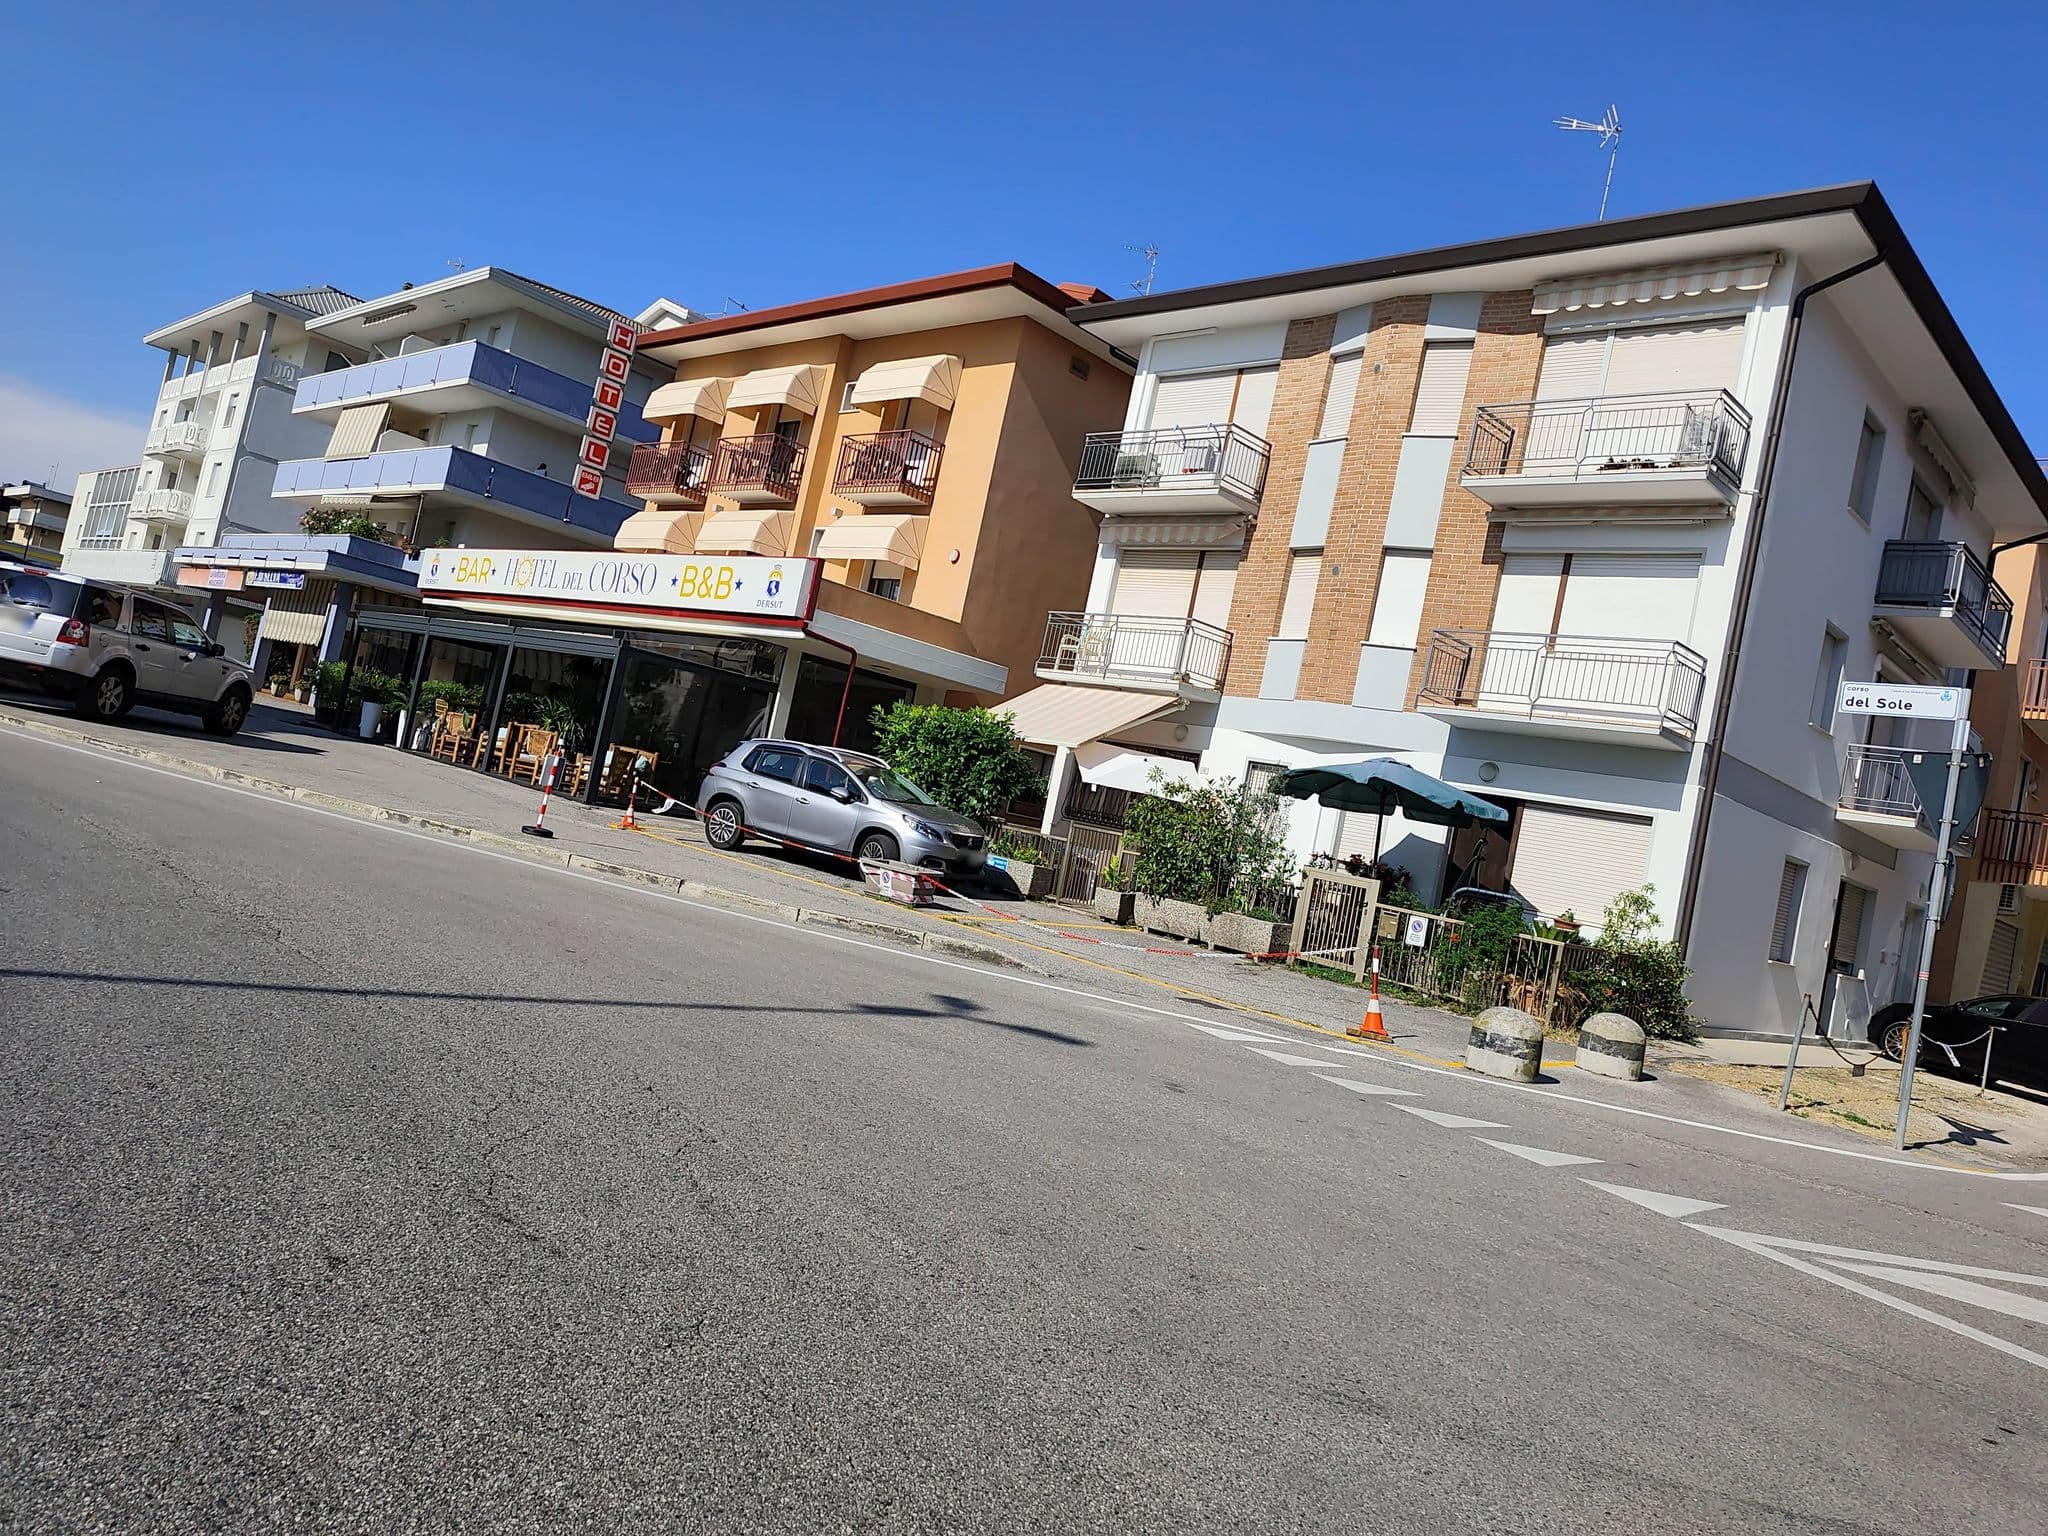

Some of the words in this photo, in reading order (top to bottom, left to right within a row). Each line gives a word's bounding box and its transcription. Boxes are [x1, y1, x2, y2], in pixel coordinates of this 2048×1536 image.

[587, 326, 633, 465] HOTEL
[455, 556, 493, 584] BAR
[503, 554, 558, 590] HOTEL
[561, 571, 584, 591] DEL
[588, 560, 658, 595] CORSO
[679, 565, 734, 600] B&B
[756, 599, 784, 609] DERSUT
[1845, 697, 1869, 708] del
[1876, 698, 1913, 711] Sole
